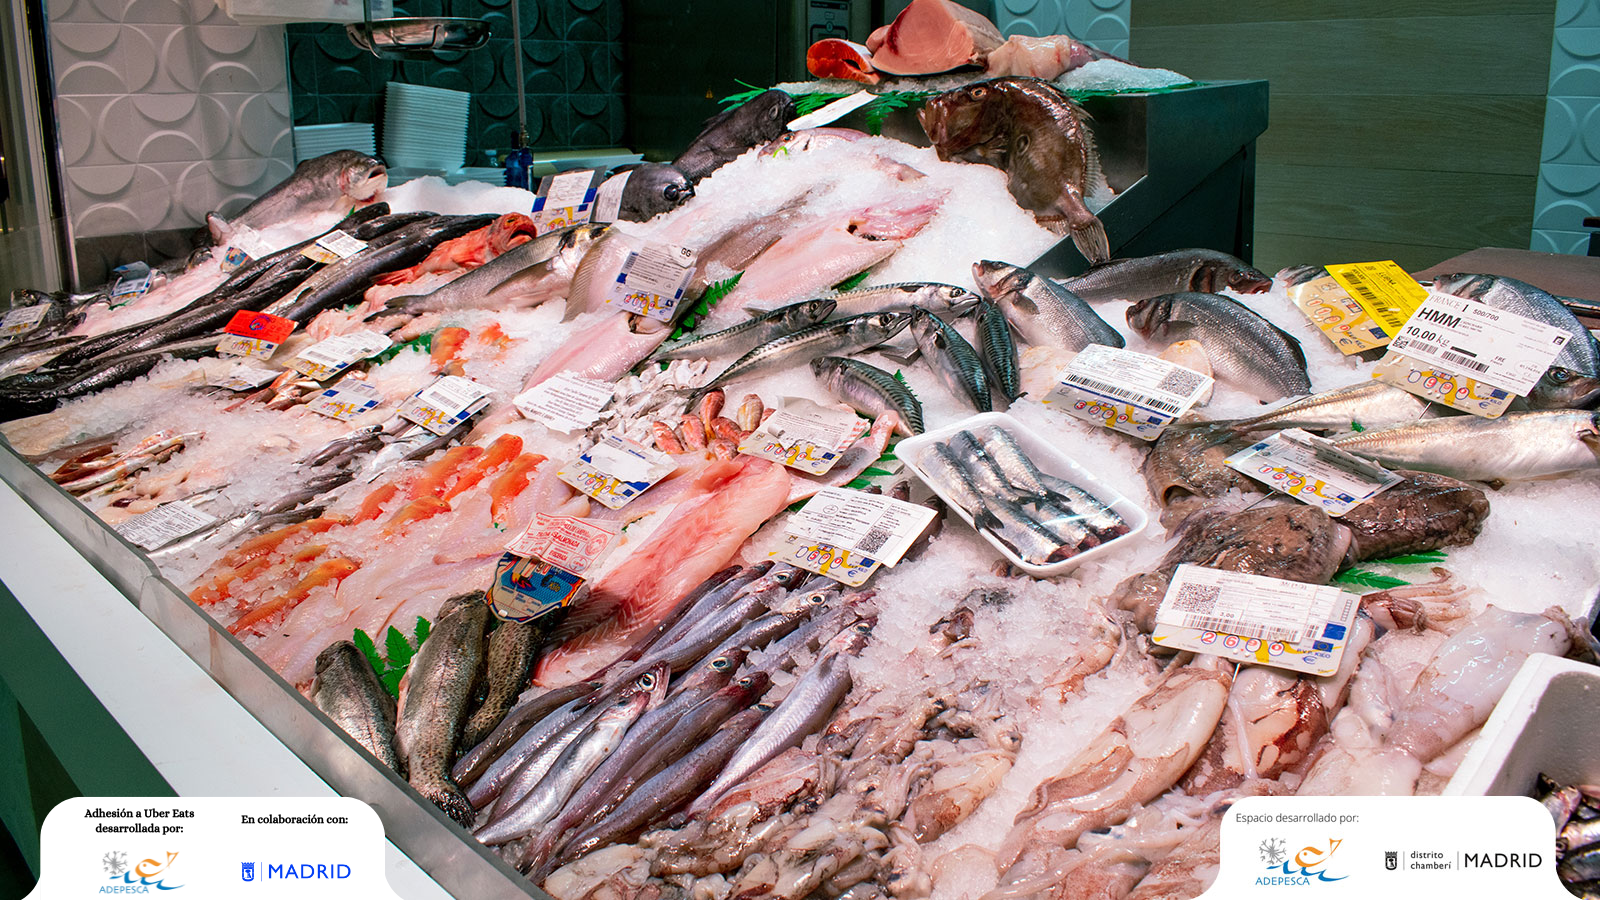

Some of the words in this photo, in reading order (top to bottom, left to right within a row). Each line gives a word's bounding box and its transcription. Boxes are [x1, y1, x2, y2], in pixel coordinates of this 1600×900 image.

[1418, 307, 1462, 328] HMM
[1429, 294, 1460, 310] FRANCE
[1473, 308, 1499, 321] 500/700
[1406, 325, 1437, 341] 10,00
